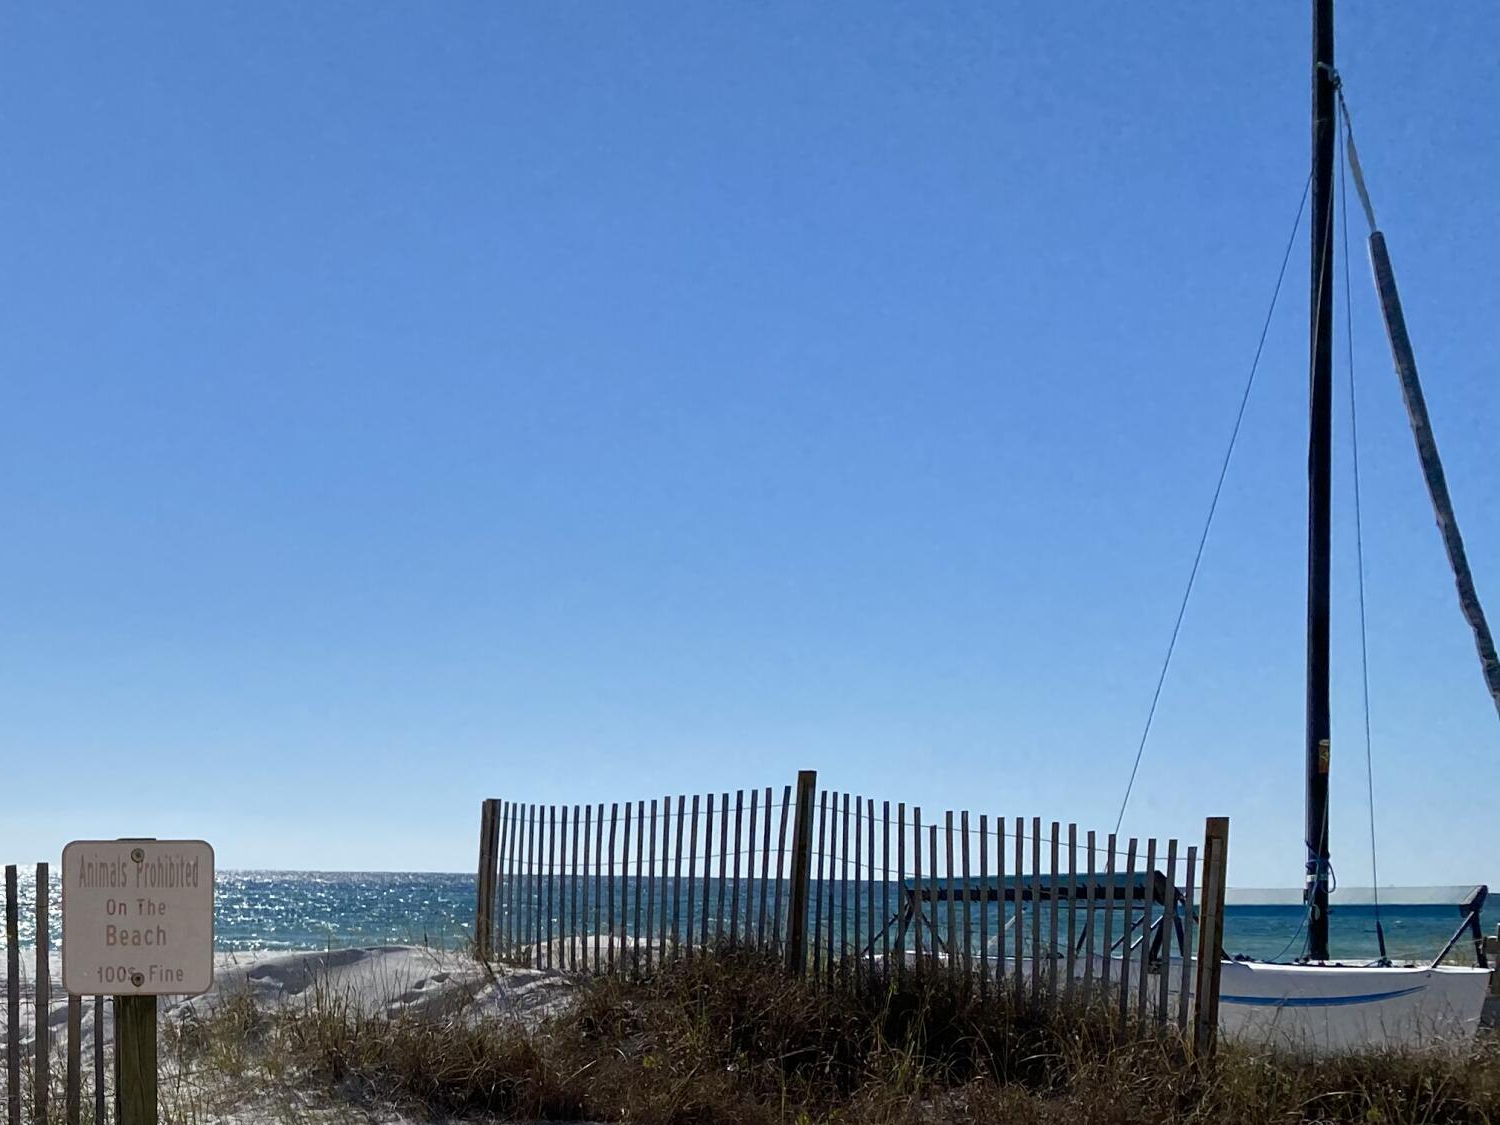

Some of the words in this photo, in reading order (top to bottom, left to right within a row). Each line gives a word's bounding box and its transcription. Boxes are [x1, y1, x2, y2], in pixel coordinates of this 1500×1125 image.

[79, 855, 127, 888] Animals
[136, 855, 199, 888] Prohibited
[106, 899, 127, 916] On
[137, 899, 167, 916] The
[106, 924, 167, 946] Beach
[149, 964, 184, 982] Fine
